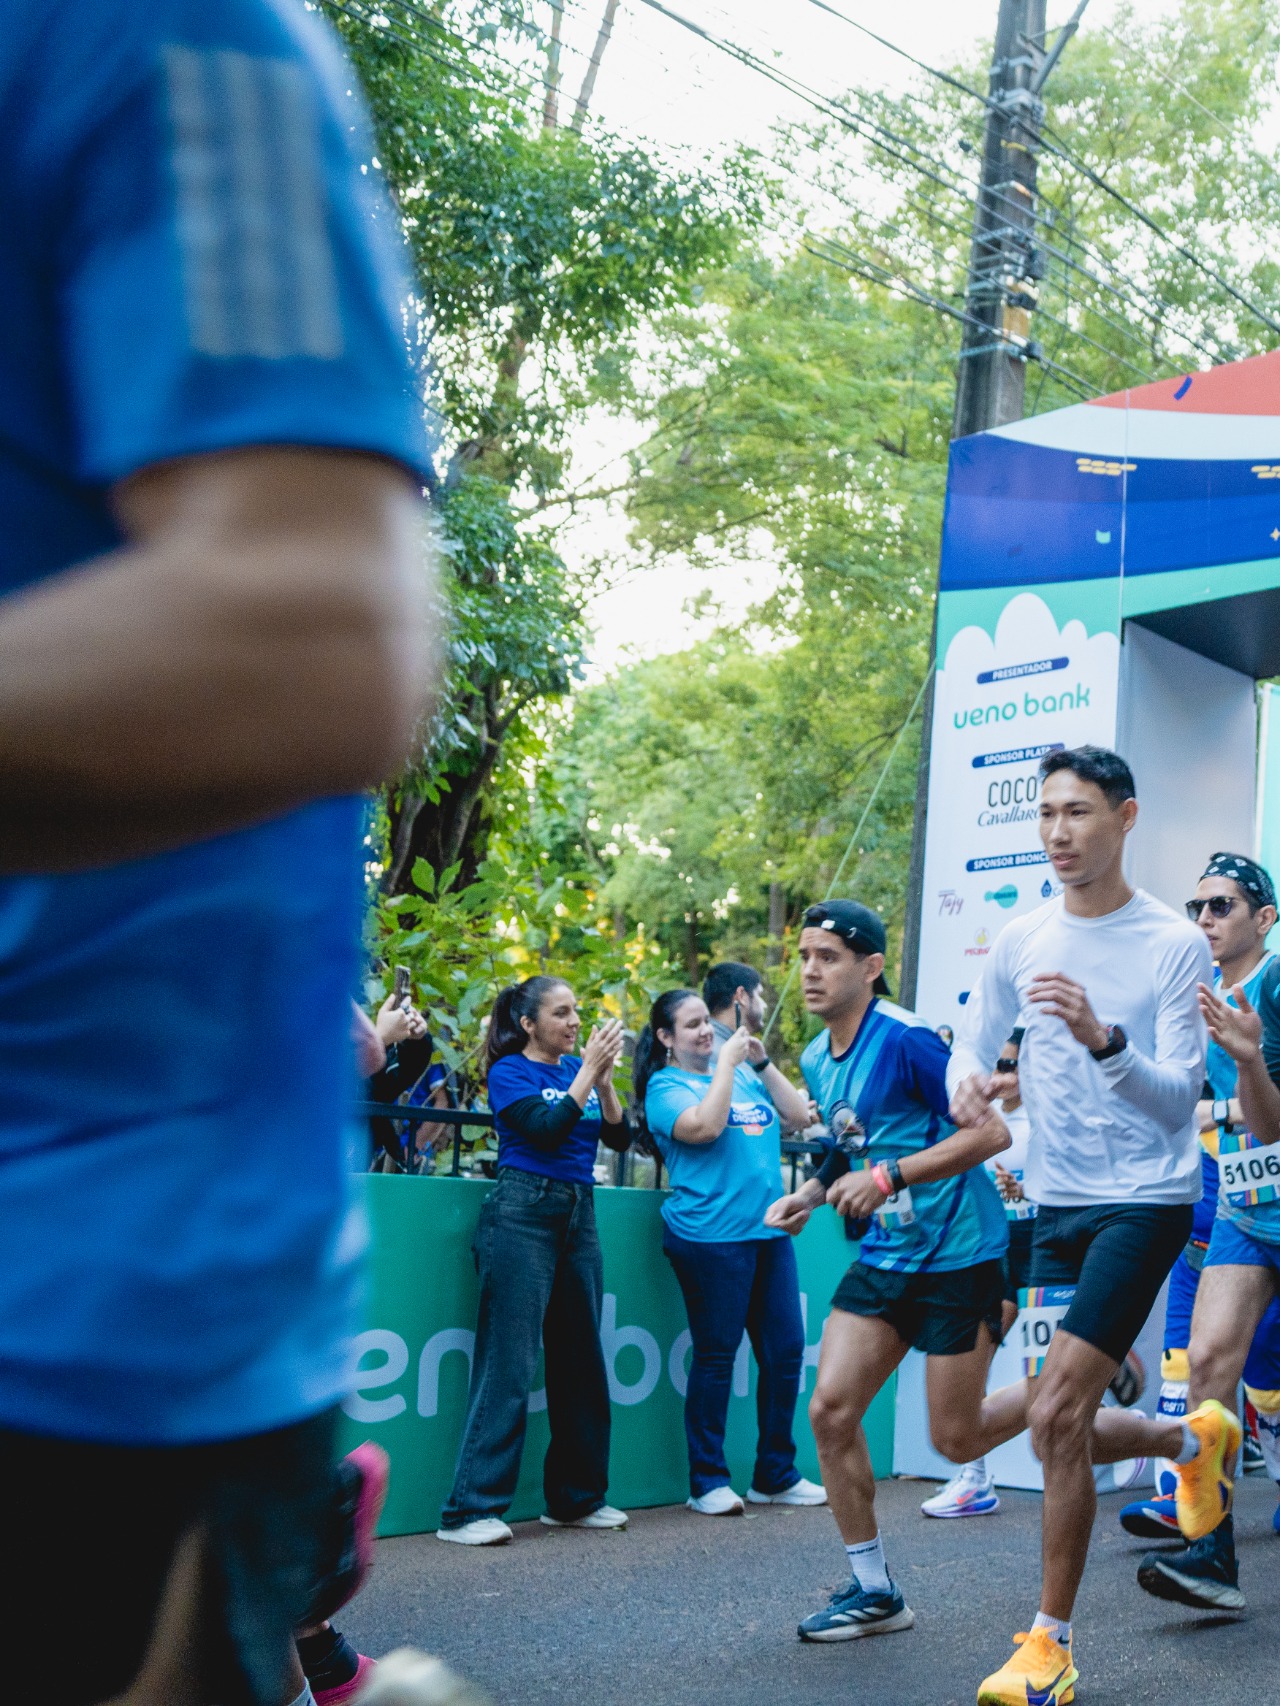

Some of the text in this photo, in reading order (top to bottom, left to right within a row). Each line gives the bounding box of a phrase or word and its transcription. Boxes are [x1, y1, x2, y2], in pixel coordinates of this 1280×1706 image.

[992, 661, 1053, 680] PRESENTADOR
[953, 682, 1090, 729] ueno bank
[984, 751, 1024, 766] SPONSOR
[988, 776, 1038, 808] COCO
[973, 857, 1014, 870] SPONSOR
